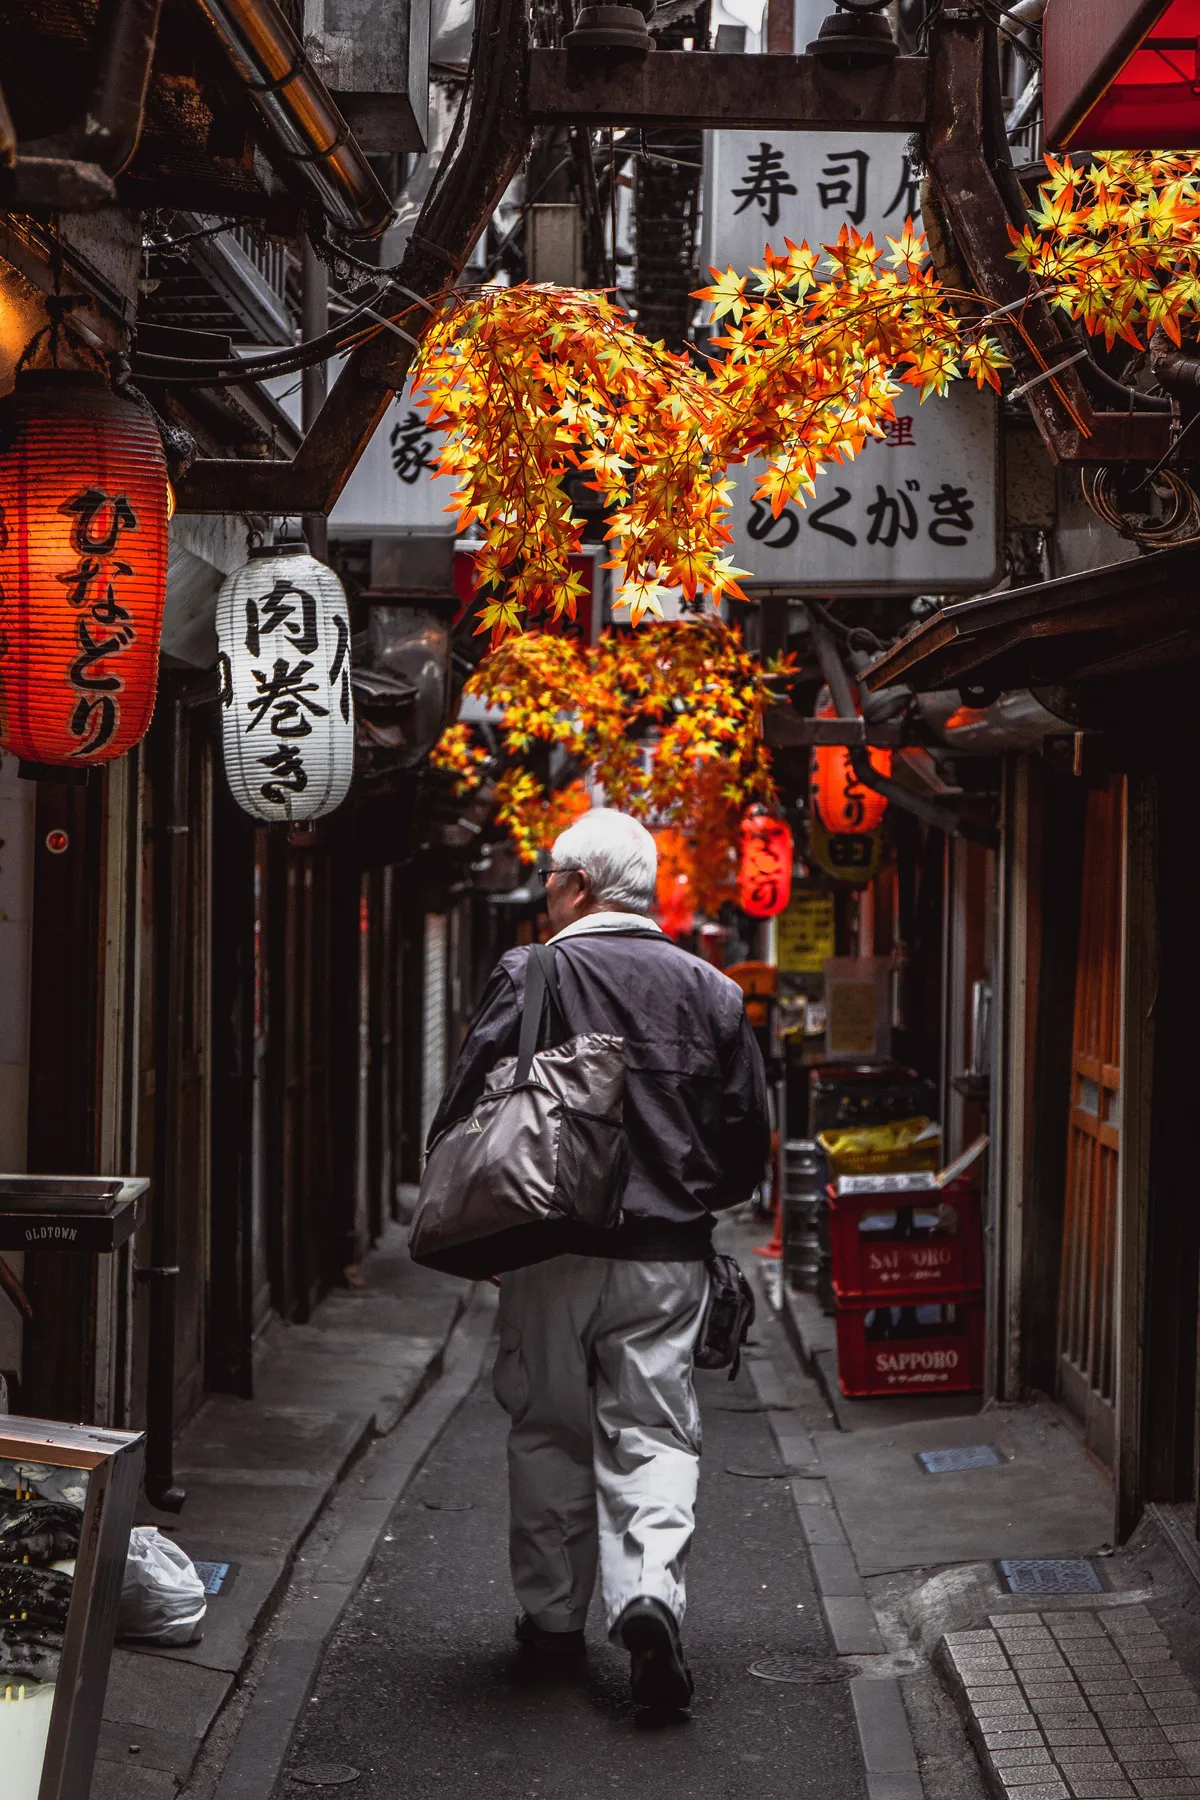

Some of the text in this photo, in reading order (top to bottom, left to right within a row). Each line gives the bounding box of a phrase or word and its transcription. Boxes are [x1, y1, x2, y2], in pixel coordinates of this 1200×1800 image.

[862, 415, 916, 449] 理
[747, 479, 975, 549] らくがき
[56, 487, 138, 757] ひなどり
[244, 580, 331, 804] 肉巻き
[25, 1226, 77, 1241] OLDTOWN
[876, 1350, 959, 1371] SAPPORO
